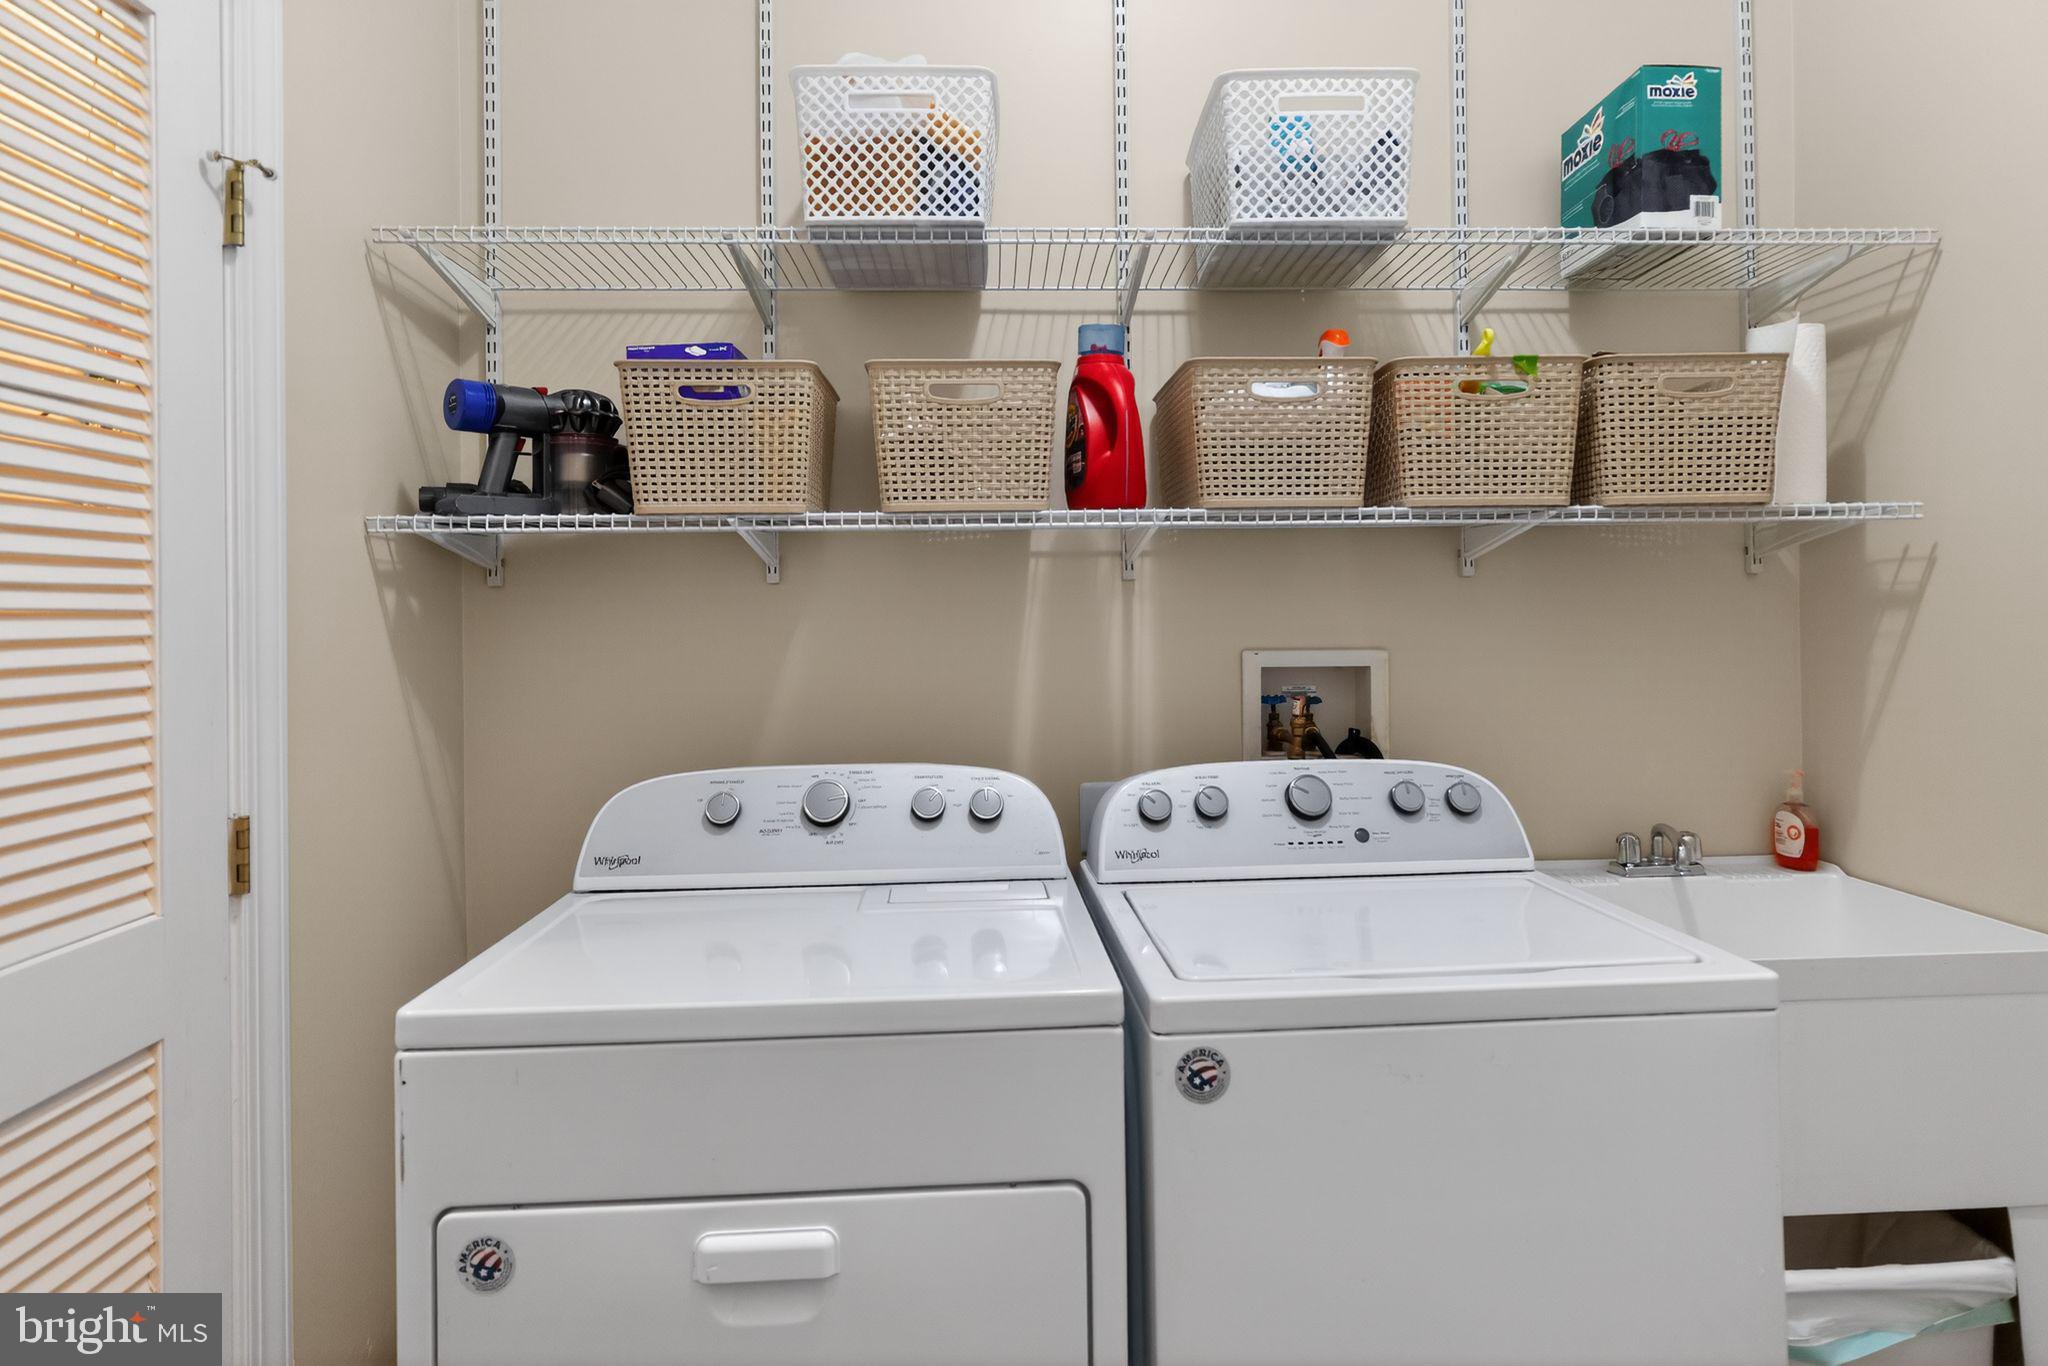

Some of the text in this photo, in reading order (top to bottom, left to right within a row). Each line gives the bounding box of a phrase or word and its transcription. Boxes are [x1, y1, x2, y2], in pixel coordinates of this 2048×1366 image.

[1649, 85, 1696, 98] moxie
[1563, 133, 1603, 178] moxie
[594, 854, 641, 870] Whirlpool
[1115, 848, 1160, 863] Whirlpool
[1177, 1048, 1225, 1073] AMERICA
[458, 1238, 502, 1273] AMERICA
